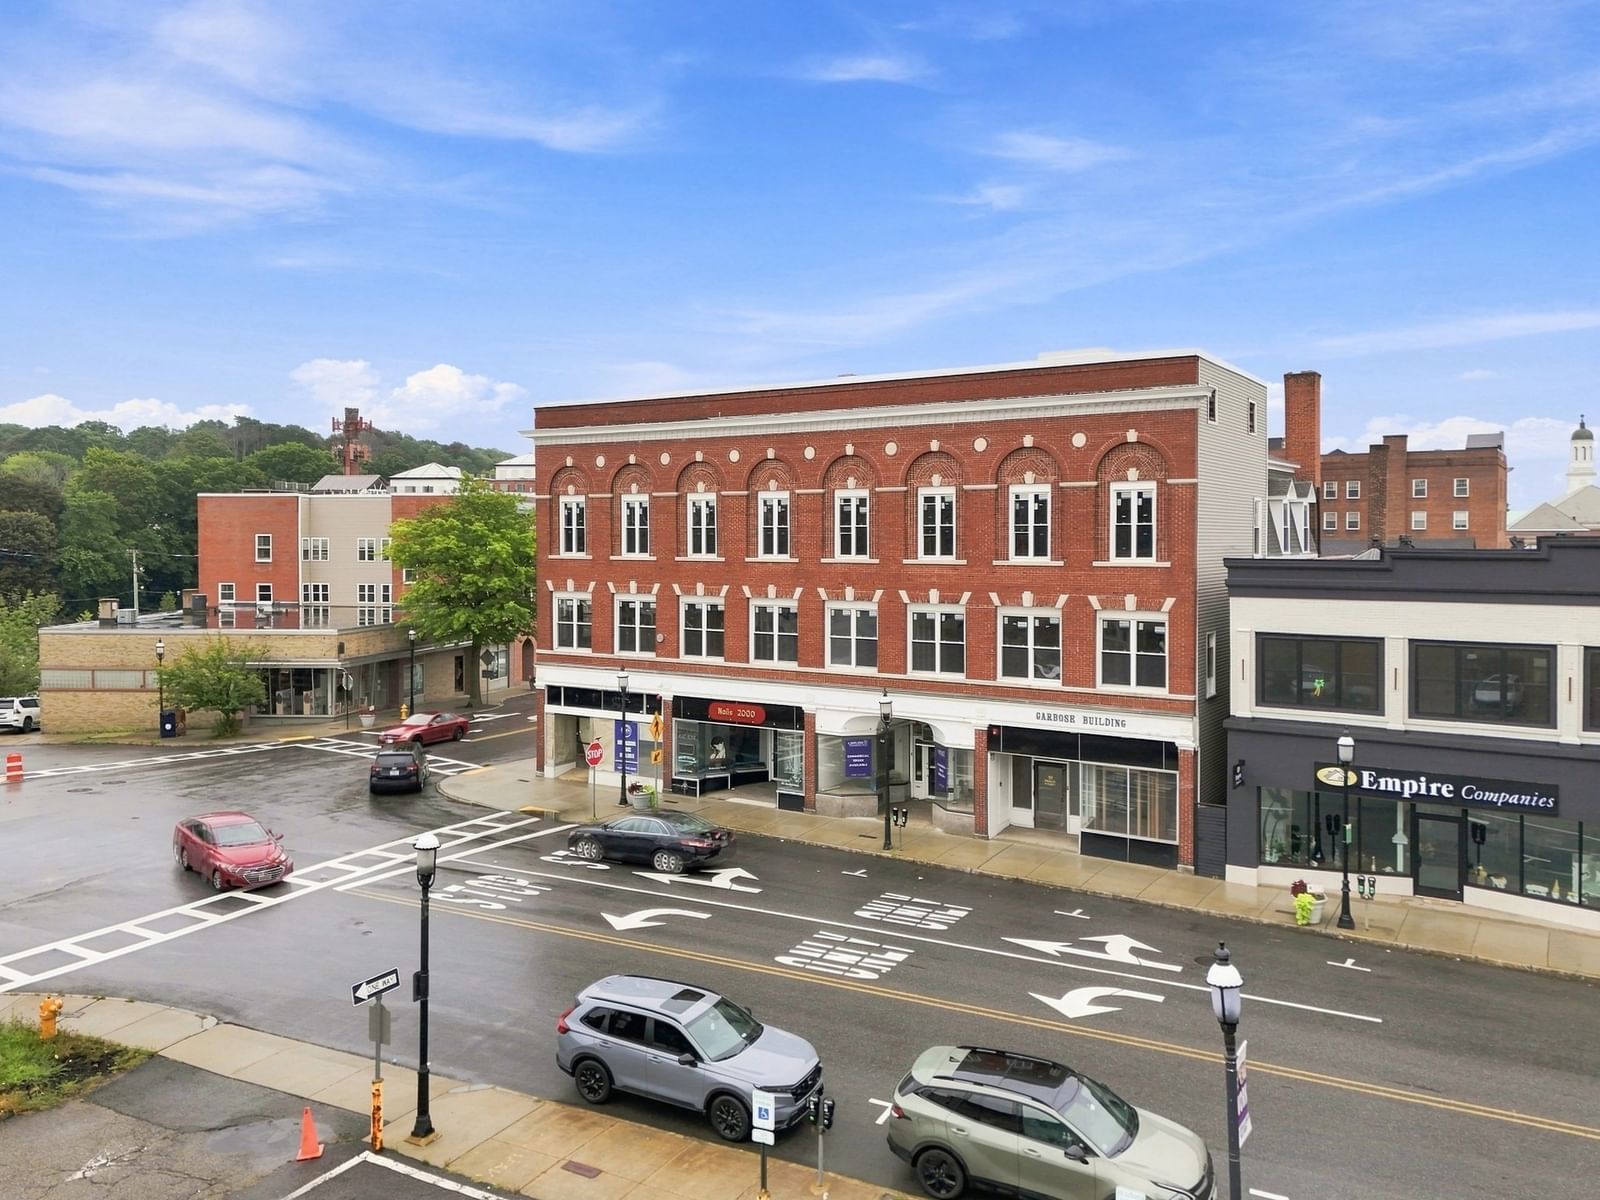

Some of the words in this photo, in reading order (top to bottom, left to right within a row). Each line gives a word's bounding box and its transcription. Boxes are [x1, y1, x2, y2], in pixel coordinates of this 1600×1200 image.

[737, 709, 756, 718] 2000
[1036, 712, 1076, 724] GARBOSE
[1082, 715, 1127, 728] BUILDING
[587, 749, 603, 760] STOP
[1360, 770, 1455, 798] Empire
[1461, 785, 1555, 808] Companies
[429, 875, 552, 909] STOP
[853, 892, 974, 931] ONLY
[774, 930, 916, 980] ONLY
